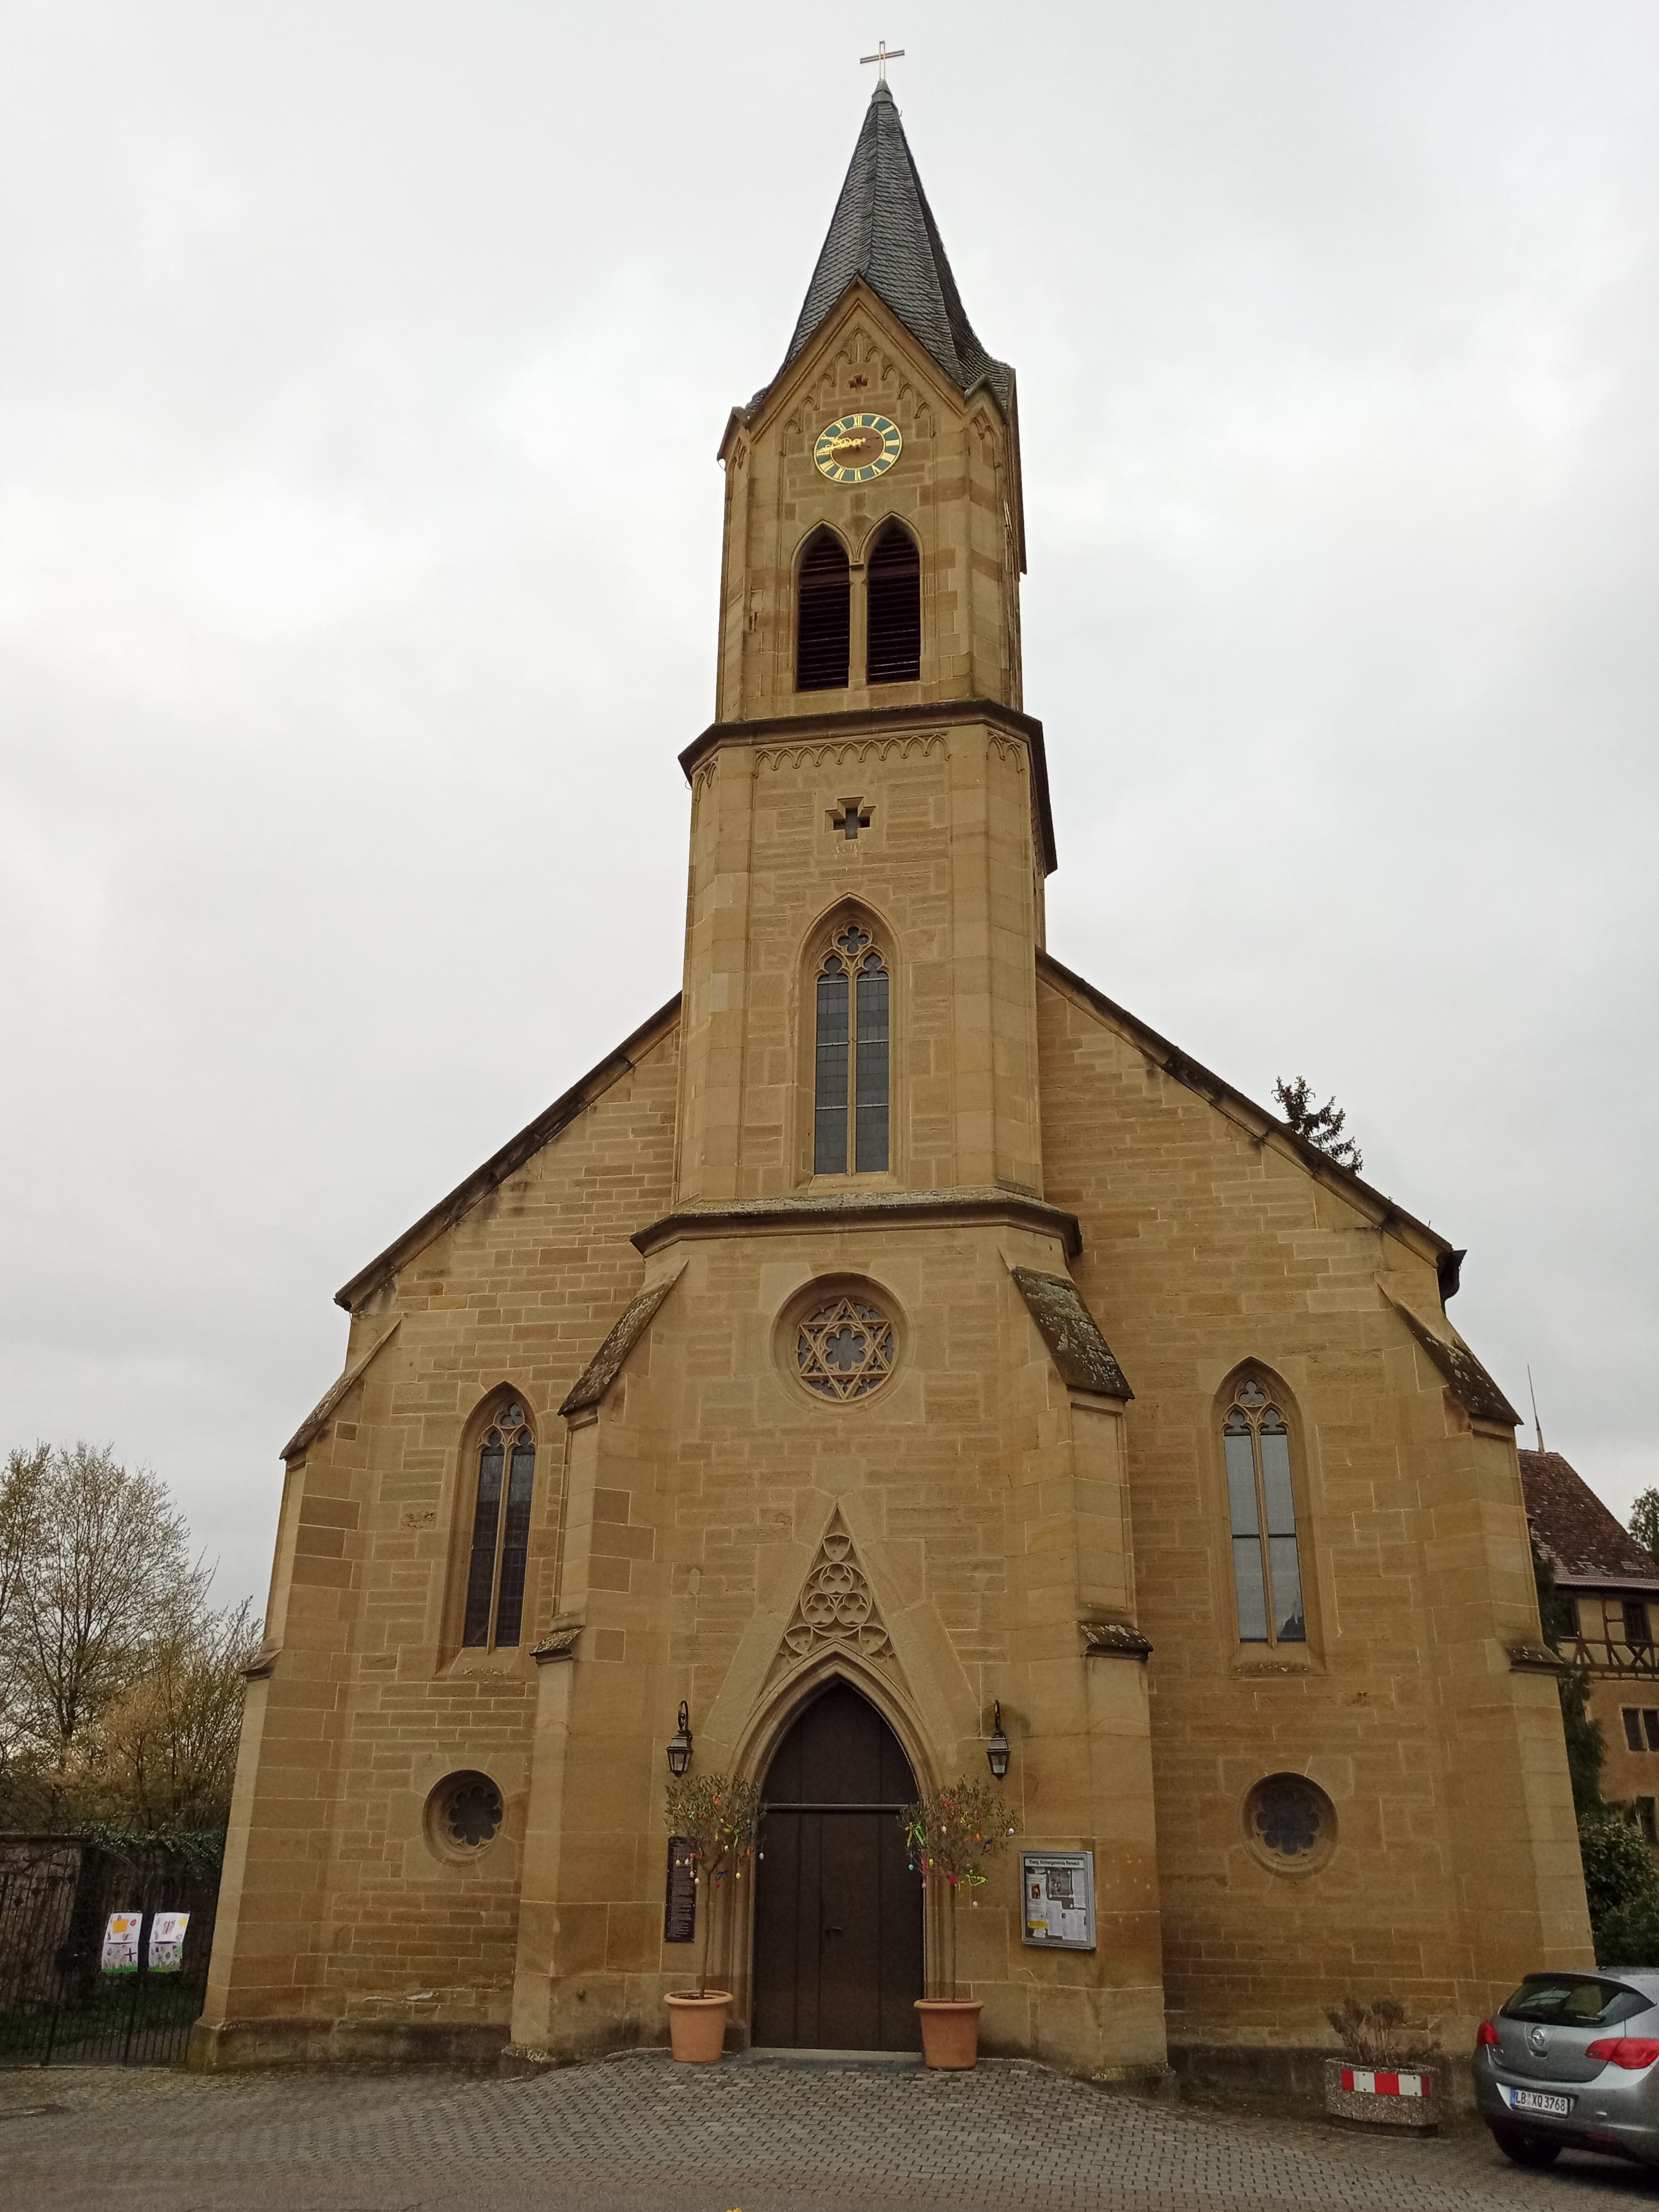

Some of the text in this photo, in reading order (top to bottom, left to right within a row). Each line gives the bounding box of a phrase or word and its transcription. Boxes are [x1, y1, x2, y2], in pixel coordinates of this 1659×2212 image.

[835, 421, 847, 432] XI
[853, 415, 862, 427] XII
[871, 416, 881, 428] I
[854, 470, 861, 481] VI
[871, 465, 882, 475] V
[1516, 2091, 1526, 2104] LB
